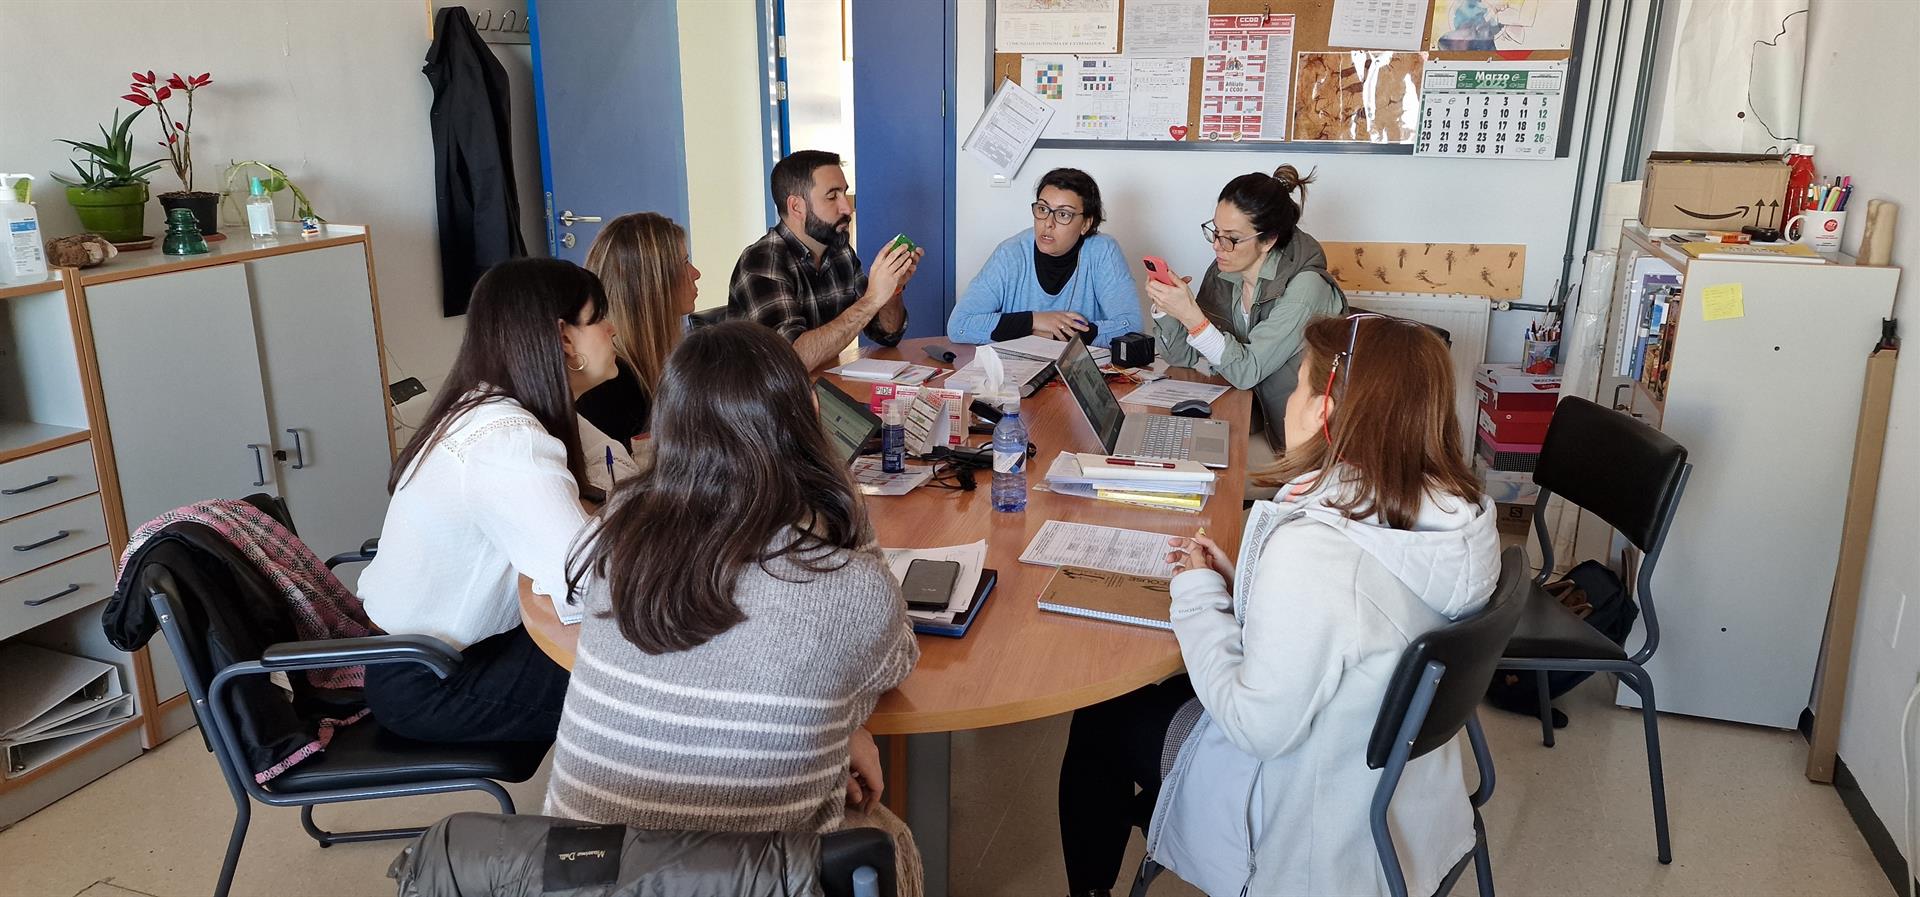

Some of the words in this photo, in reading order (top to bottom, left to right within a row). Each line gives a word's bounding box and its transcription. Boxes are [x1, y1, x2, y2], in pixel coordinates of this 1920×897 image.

[1475, 72, 1509, 81] Marzo
[1475, 80, 1508, 89] 2023
[1466, 96, 1470, 105] 1
[1484, 97, 1489, 105] 2
[1503, 97, 1509, 106] 3
[1523, 97, 1528, 106] 4
[1542, 98, 1547, 106] 5
[1426, 108, 1432, 117] 6
[1446, 108, 1450, 117] 7
[1464, 108, 1469, 117] 8
[1483, 109, 1488, 117] 9
[1500, 109, 1509, 118] 10
[1520, 109, 1527, 118] 11
[1539, 109, 1548, 118] 12
[1424, 120, 1432, 128] 13
[1442, 120, 1451, 129] 14
[1461, 120, 1469, 129] 15
[1480, 121, 1488, 129] 16
[1499, 121, 1507, 130] 17
[1518, 121, 1527, 130] 18
[1537, 122, 1546, 130] 19
[1422, 132, 1431, 140] 20
[1440, 132, 1449, 141] 21
[1459, 132, 1468, 141] 22
[1477, 132, 1487, 141] 23
[1496, 133, 1506, 142] 24
[1515, 133, 1525, 142] 25
[1534, 134, 1544, 142] 26
[1420, 143, 1429, 152] 27
[1439, 144, 1448, 152] 28
[1457, 144, 1467, 153] 29
[1476, 144, 1485, 153] 30
[1495, 145, 1504, 154] 31
